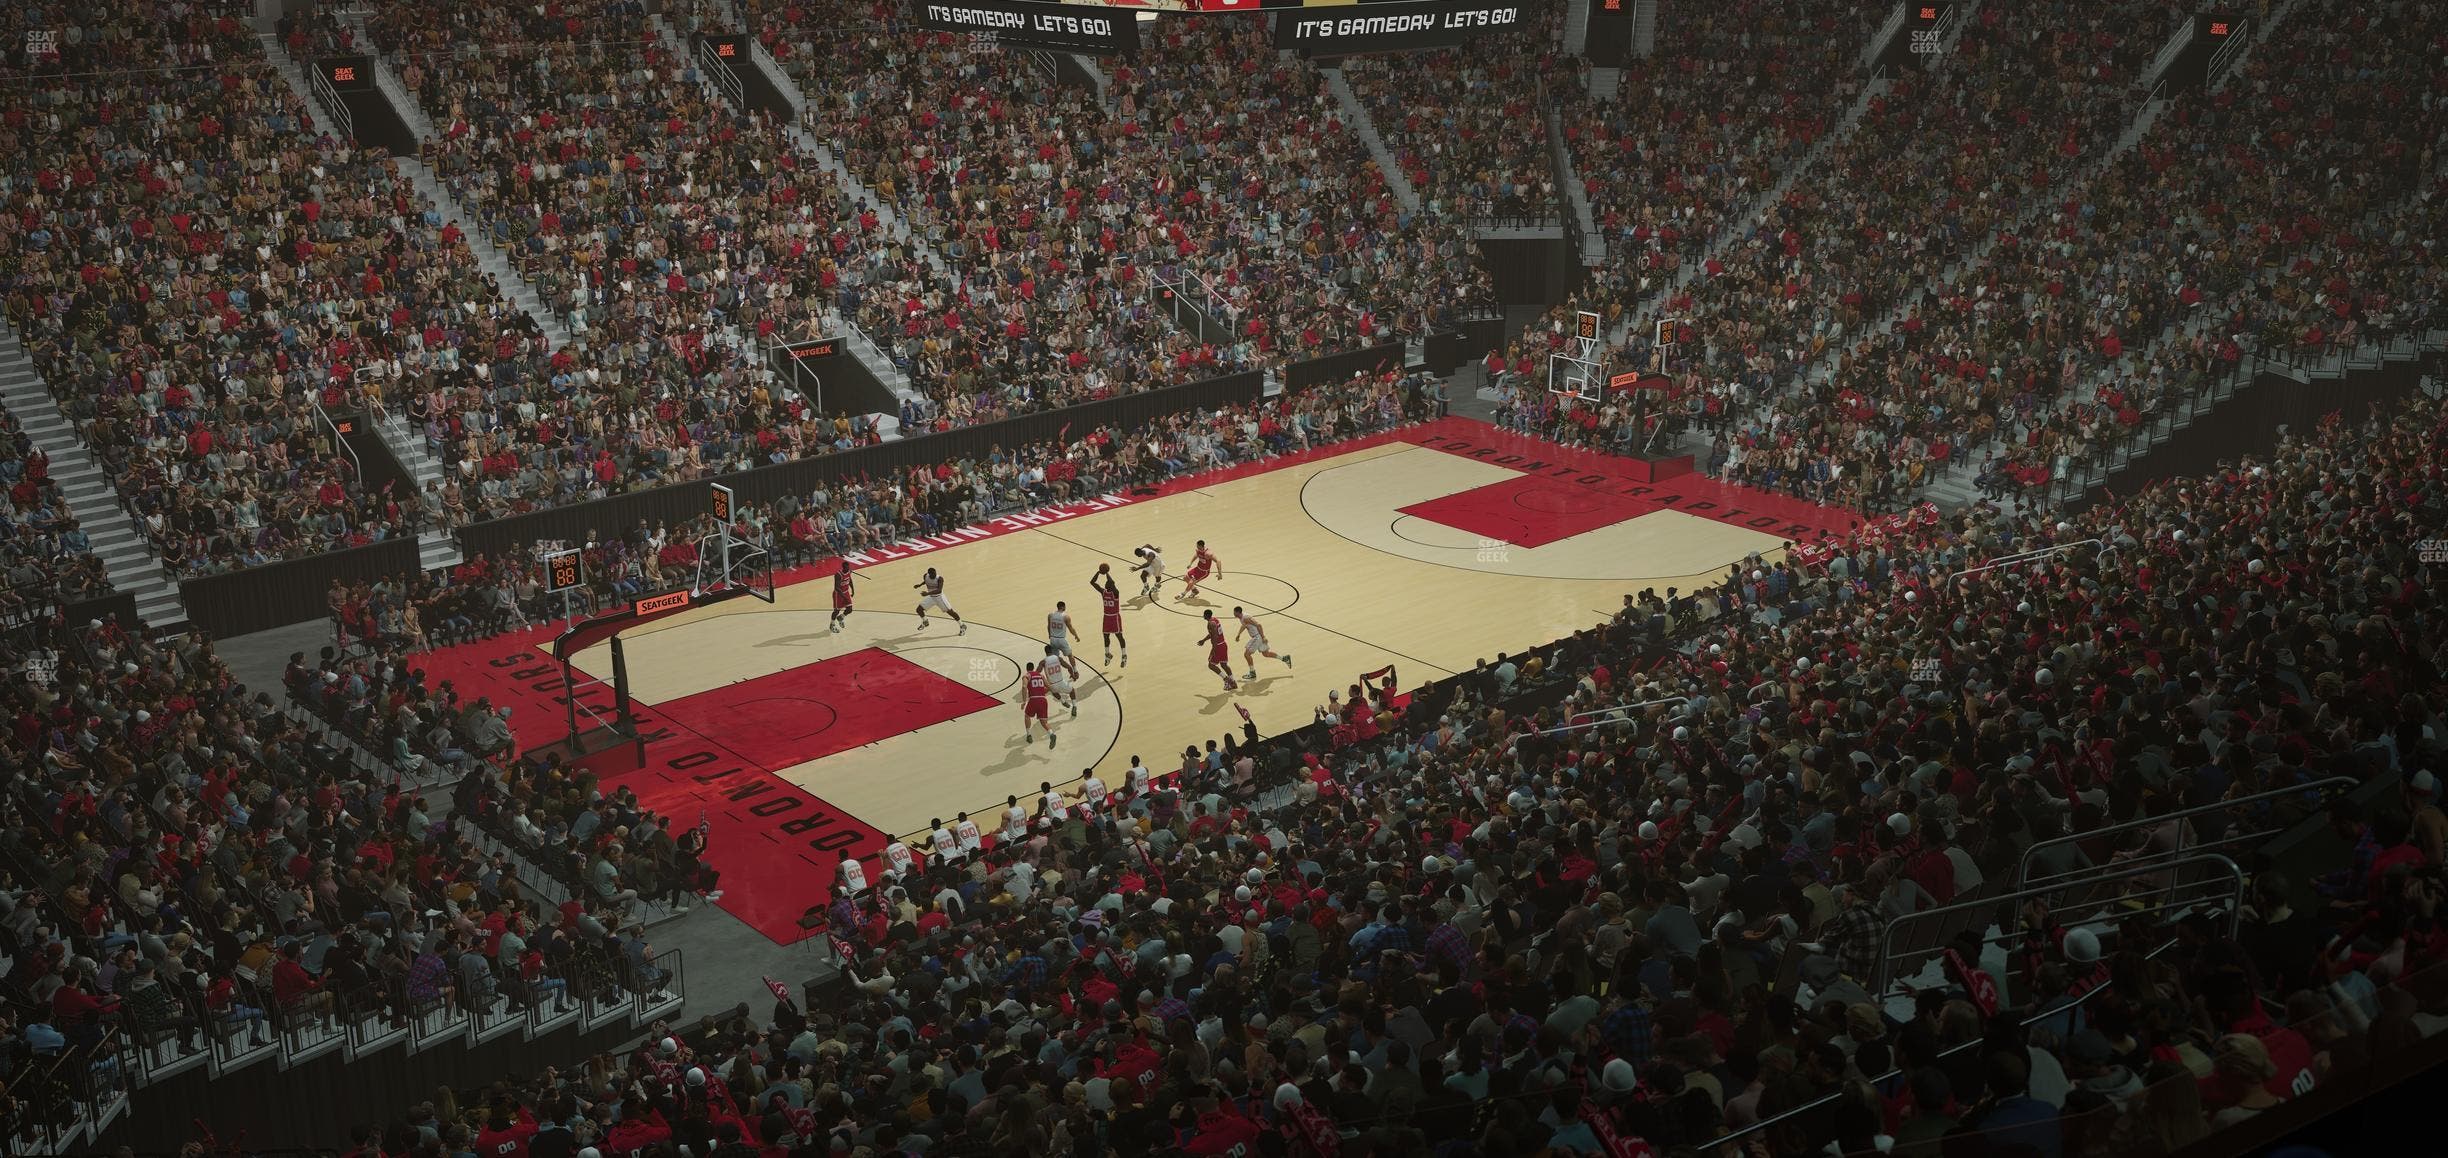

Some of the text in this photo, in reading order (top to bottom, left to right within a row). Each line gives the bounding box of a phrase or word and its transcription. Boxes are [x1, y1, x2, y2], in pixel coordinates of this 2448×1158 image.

[928, 5, 1112, 36] IT'S GAMEDAY LET'S GO!
[1296, 7, 1517, 38] IT'S GAMEDAY LET'S GO!
[1421, 436, 1606, 485] TORONTO
[715, 501, 727, 518] 88
[991, 506, 1077, 530] THE
[557, 568, 575, 586] 88
[642, 594, 684, 612] SEATGEEK
[892, 849, 908, 862] 00
[1137, 1069, 1155, 1086] 00
[2292, 1067, 2315, 1097] 00
[497, 1140, 517, 1154] 00
